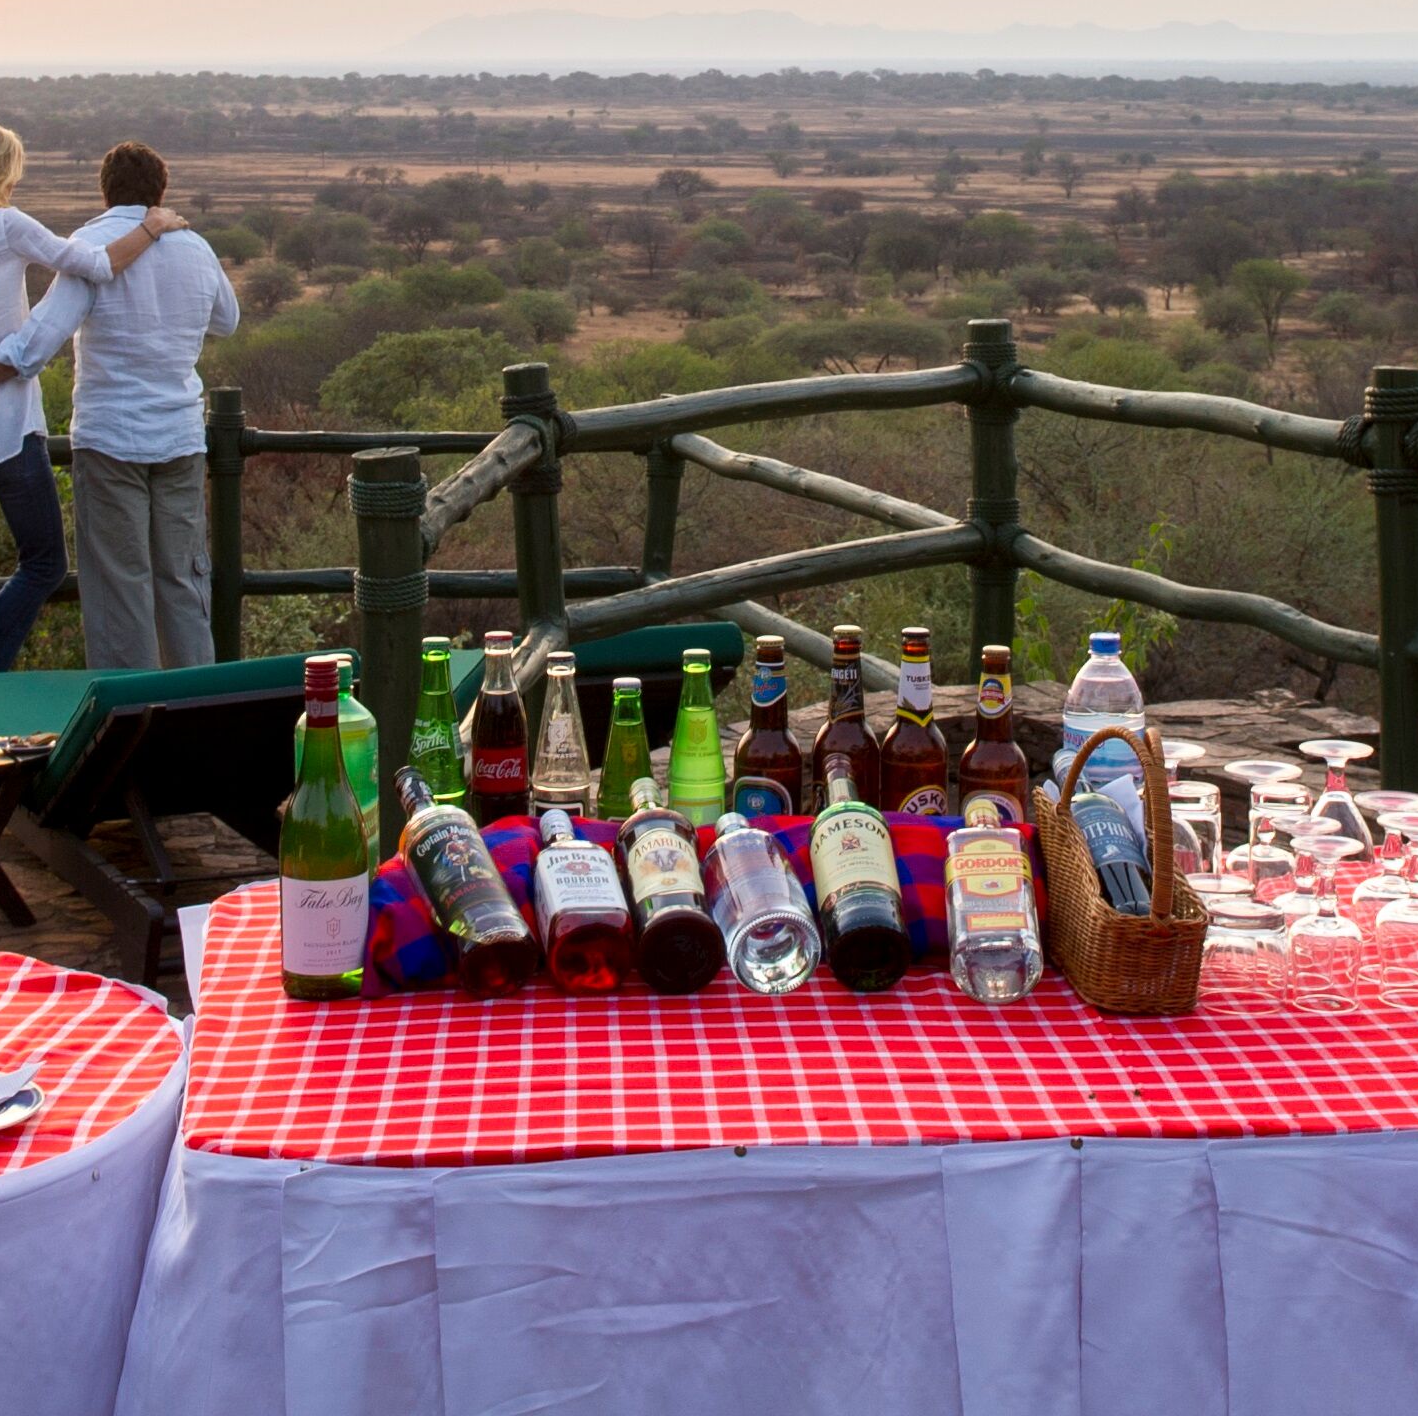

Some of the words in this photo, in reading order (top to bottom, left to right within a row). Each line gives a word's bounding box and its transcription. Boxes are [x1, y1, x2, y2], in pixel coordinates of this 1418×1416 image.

[413, 734, 447, 753] Sprite
[416, 828, 450, 858] Captain
[814, 818, 885, 855] JAMESON
[546, 854, 569, 870] JIM
[571, 852, 609, 866] BEAM
[555, 876, 610, 885] BOURBON
[295, 888, 334, 910] False
[335, 885, 364, 913] Bay
